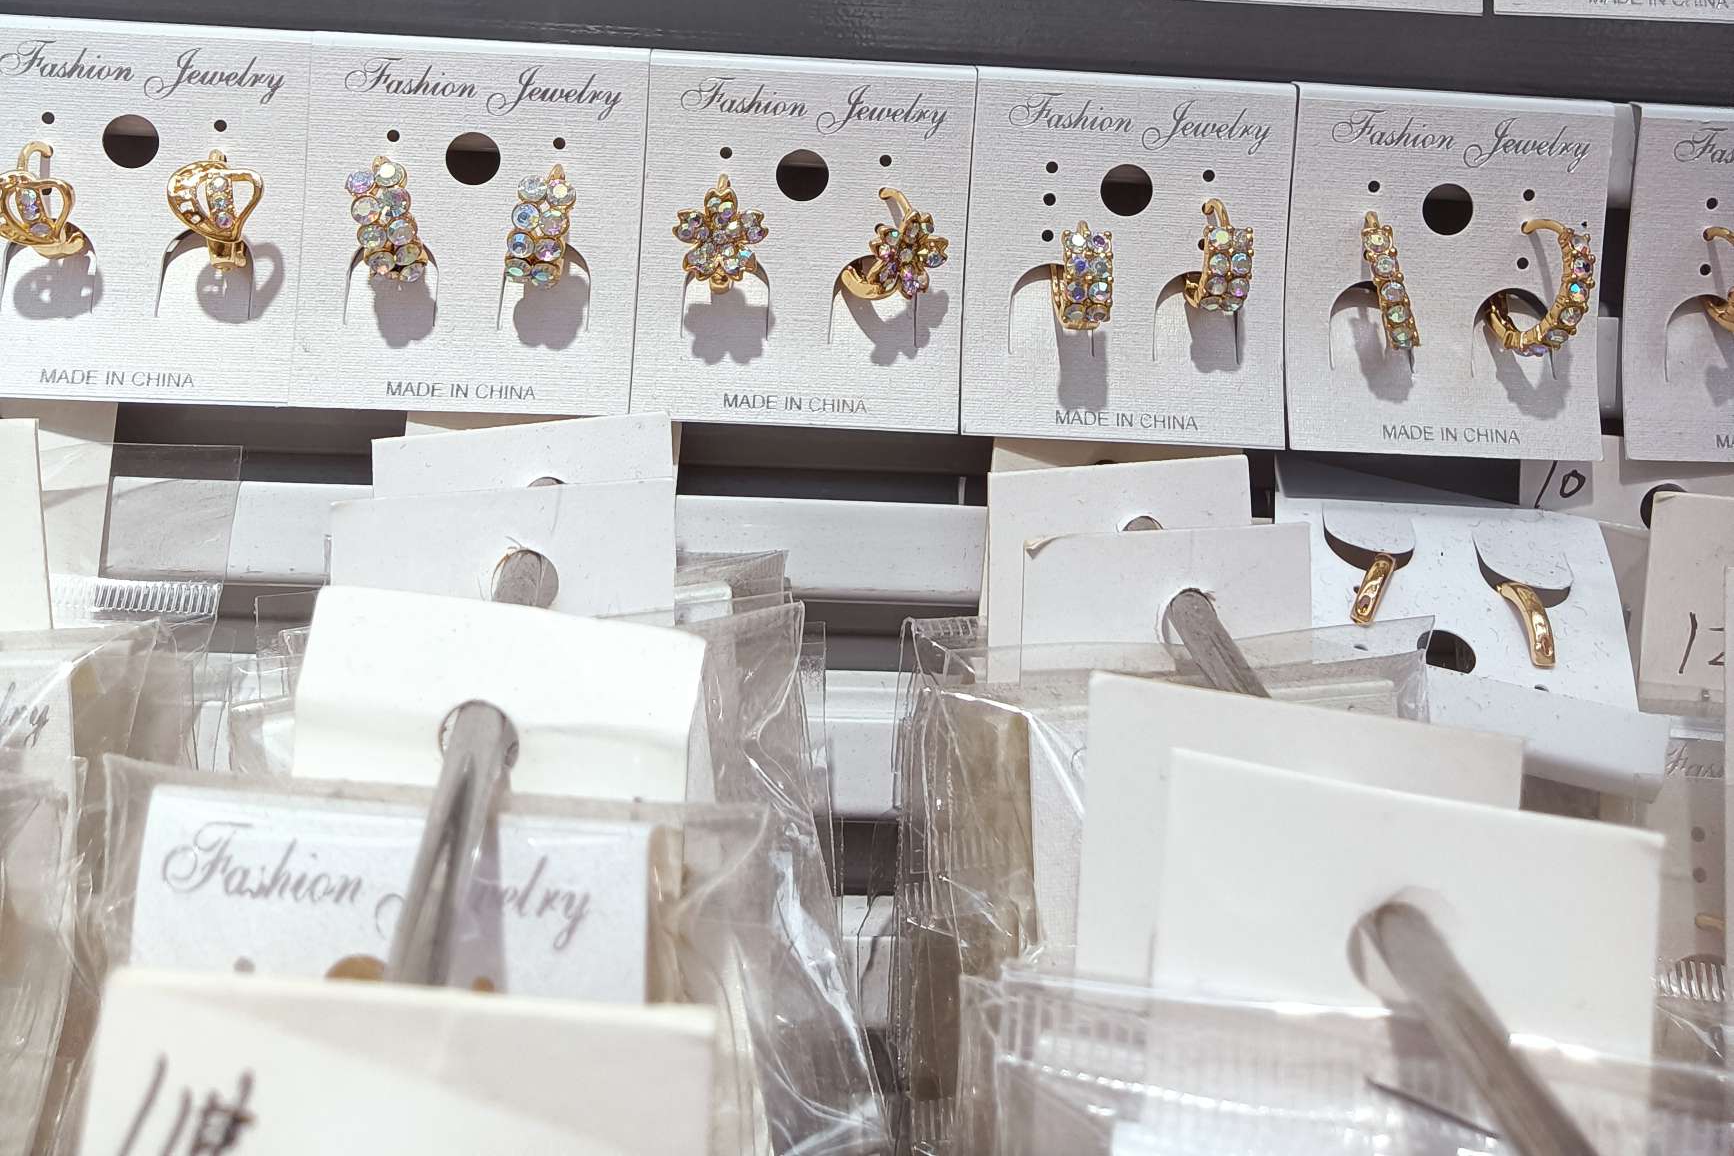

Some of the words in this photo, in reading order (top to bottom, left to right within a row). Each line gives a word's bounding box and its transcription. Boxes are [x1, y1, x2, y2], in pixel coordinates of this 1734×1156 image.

[0, 40, 135, 82] Fashion
[144, 47, 286, 105] Jewelry
[345, 57, 477, 99] Fashion
[486, 65, 623, 121] Jewelry
[680, 76, 808, 117] Fashion
[816, 84, 948, 141] Jewelry
[1009, 92, 1134, 133] Fashion
[1141, 99, 1272, 155] Jewelry
[1331, 109, 1456, 150] Fashion
[1463, 117, 1591, 173] Jewelry
[39, 369, 100, 385] MADE
[105, 371, 125, 386] IN
[131, 372, 195, 388] CHINA
[385, 382, 444, 398] MADE
[450, 383, 469, 399] IN
[475, 384, 536, 401] CHINA
[723, 393, 778, 409] MADE
[784, 395, 803, 411] IN
[809, 396, 868, 414] CHINA
[1055, 410, 1110, 427] MADE
[1116, 412, 1134, 428] IN
[1140, 413, 1199, 432] CHINA
[1382, 424, 1435, 441] MADE
[1440, 427, 1458, 443] IN
[1463, 428, 1521, 445] CHINA
[162, 820, 363, 906] Fashion
